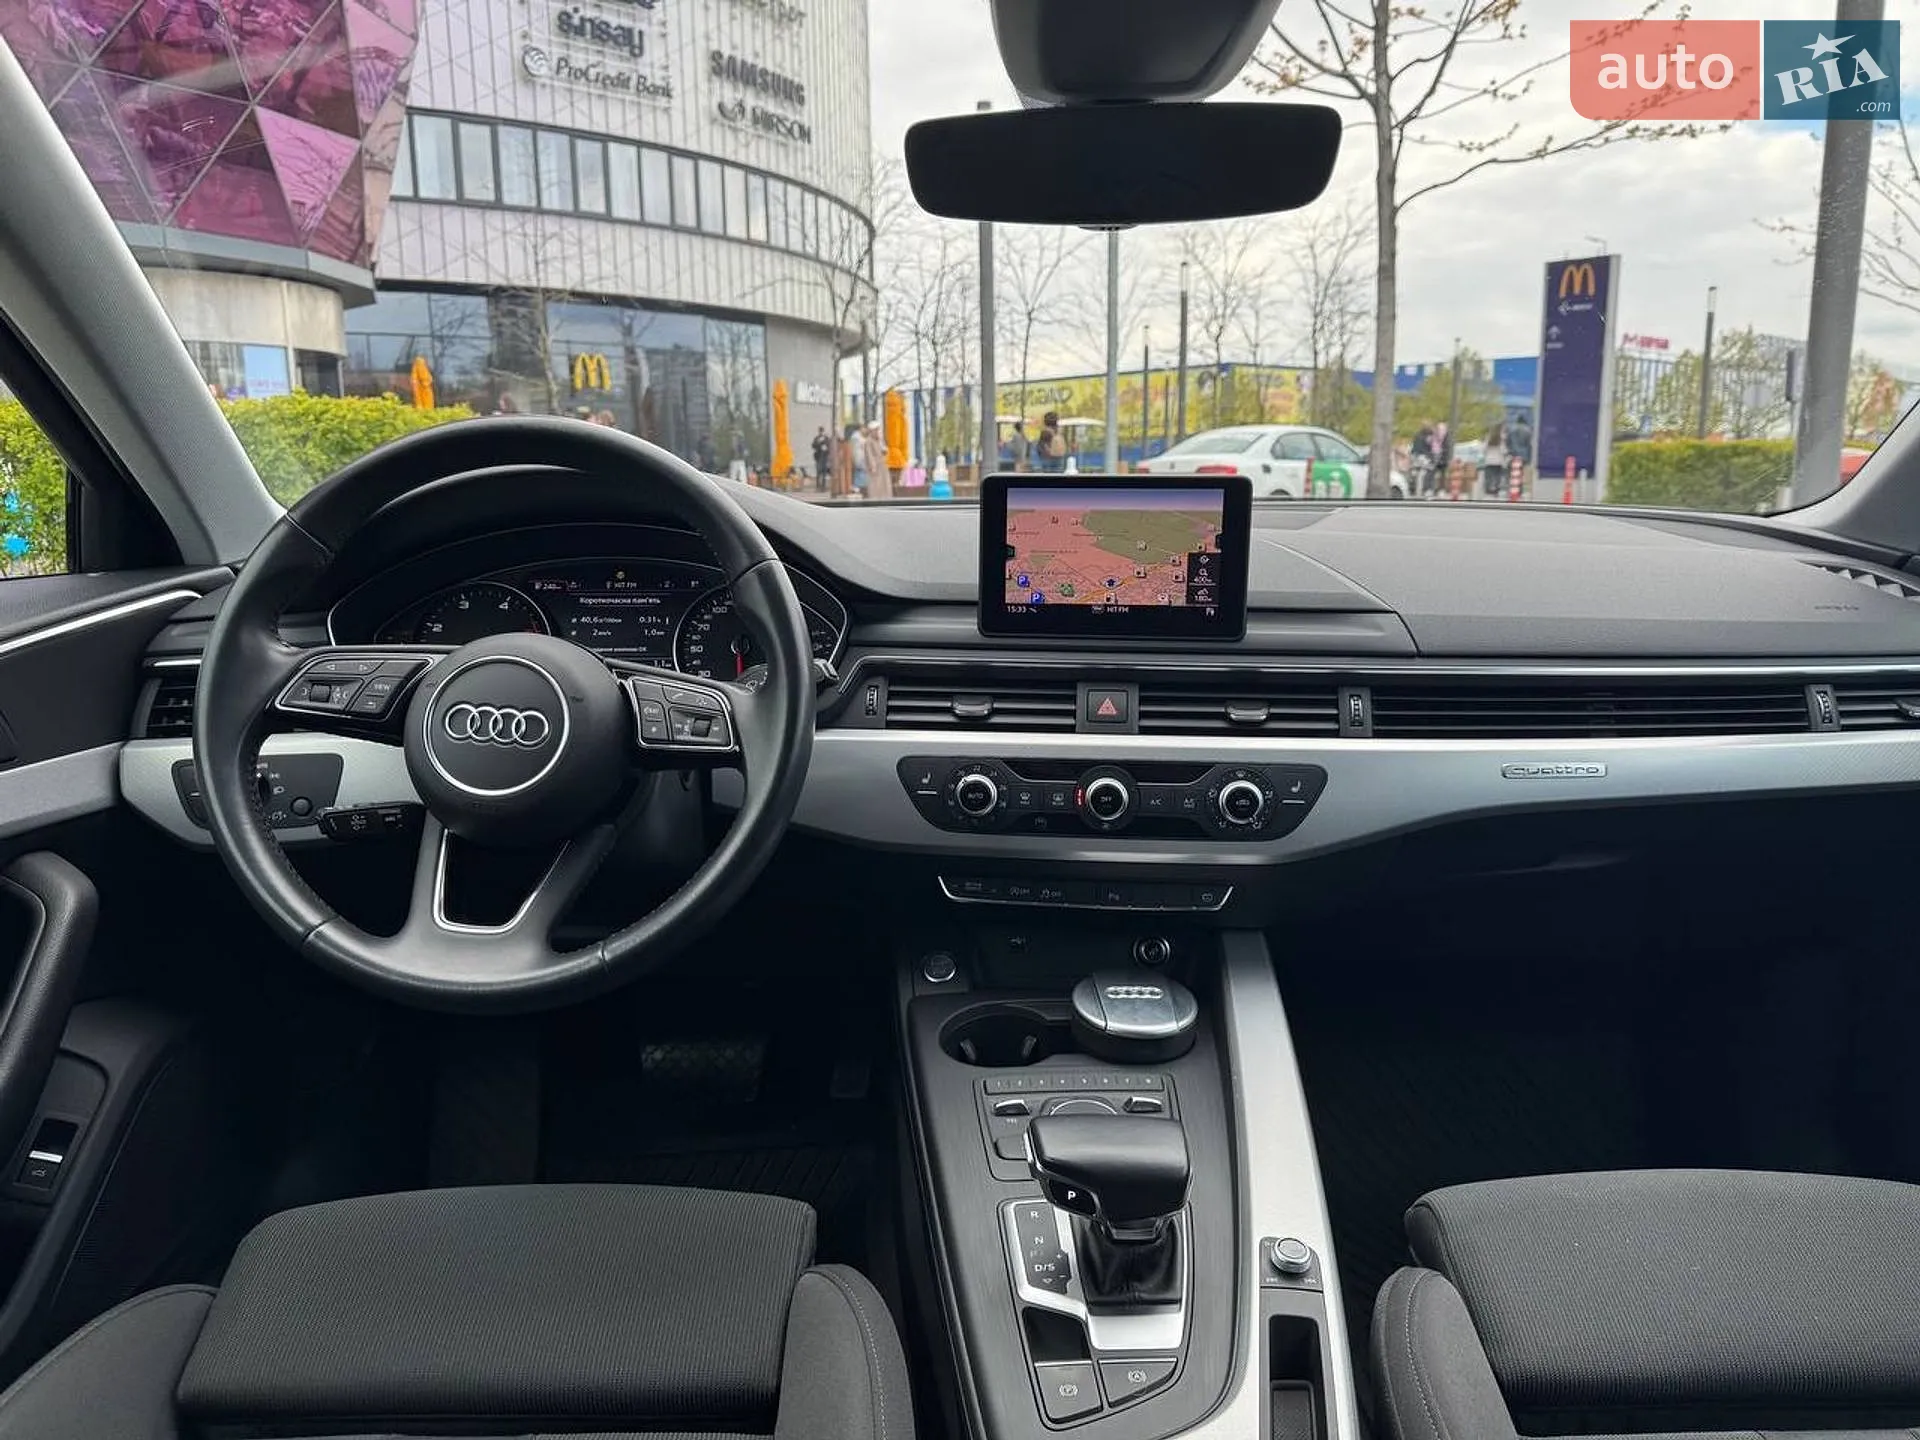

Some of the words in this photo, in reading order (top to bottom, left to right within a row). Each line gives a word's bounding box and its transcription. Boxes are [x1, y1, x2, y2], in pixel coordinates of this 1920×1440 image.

[557, 7, 644, 58] sinsay
[556, 57, 631, 90] ProCredit
[636, 75, 673, 99] Bank
[710, 50, 805, 107] SAMSUNG
[498, 601, 509, 611] 4
[1510, 764, 1600, 778] quattro
[1067, 1190, 1076, 1200] P
[1030, 1210, 1039, 1219] R
[1034, 1236, 1044, 1245] N
[1034, 1262, 1056, 1272] D/S
